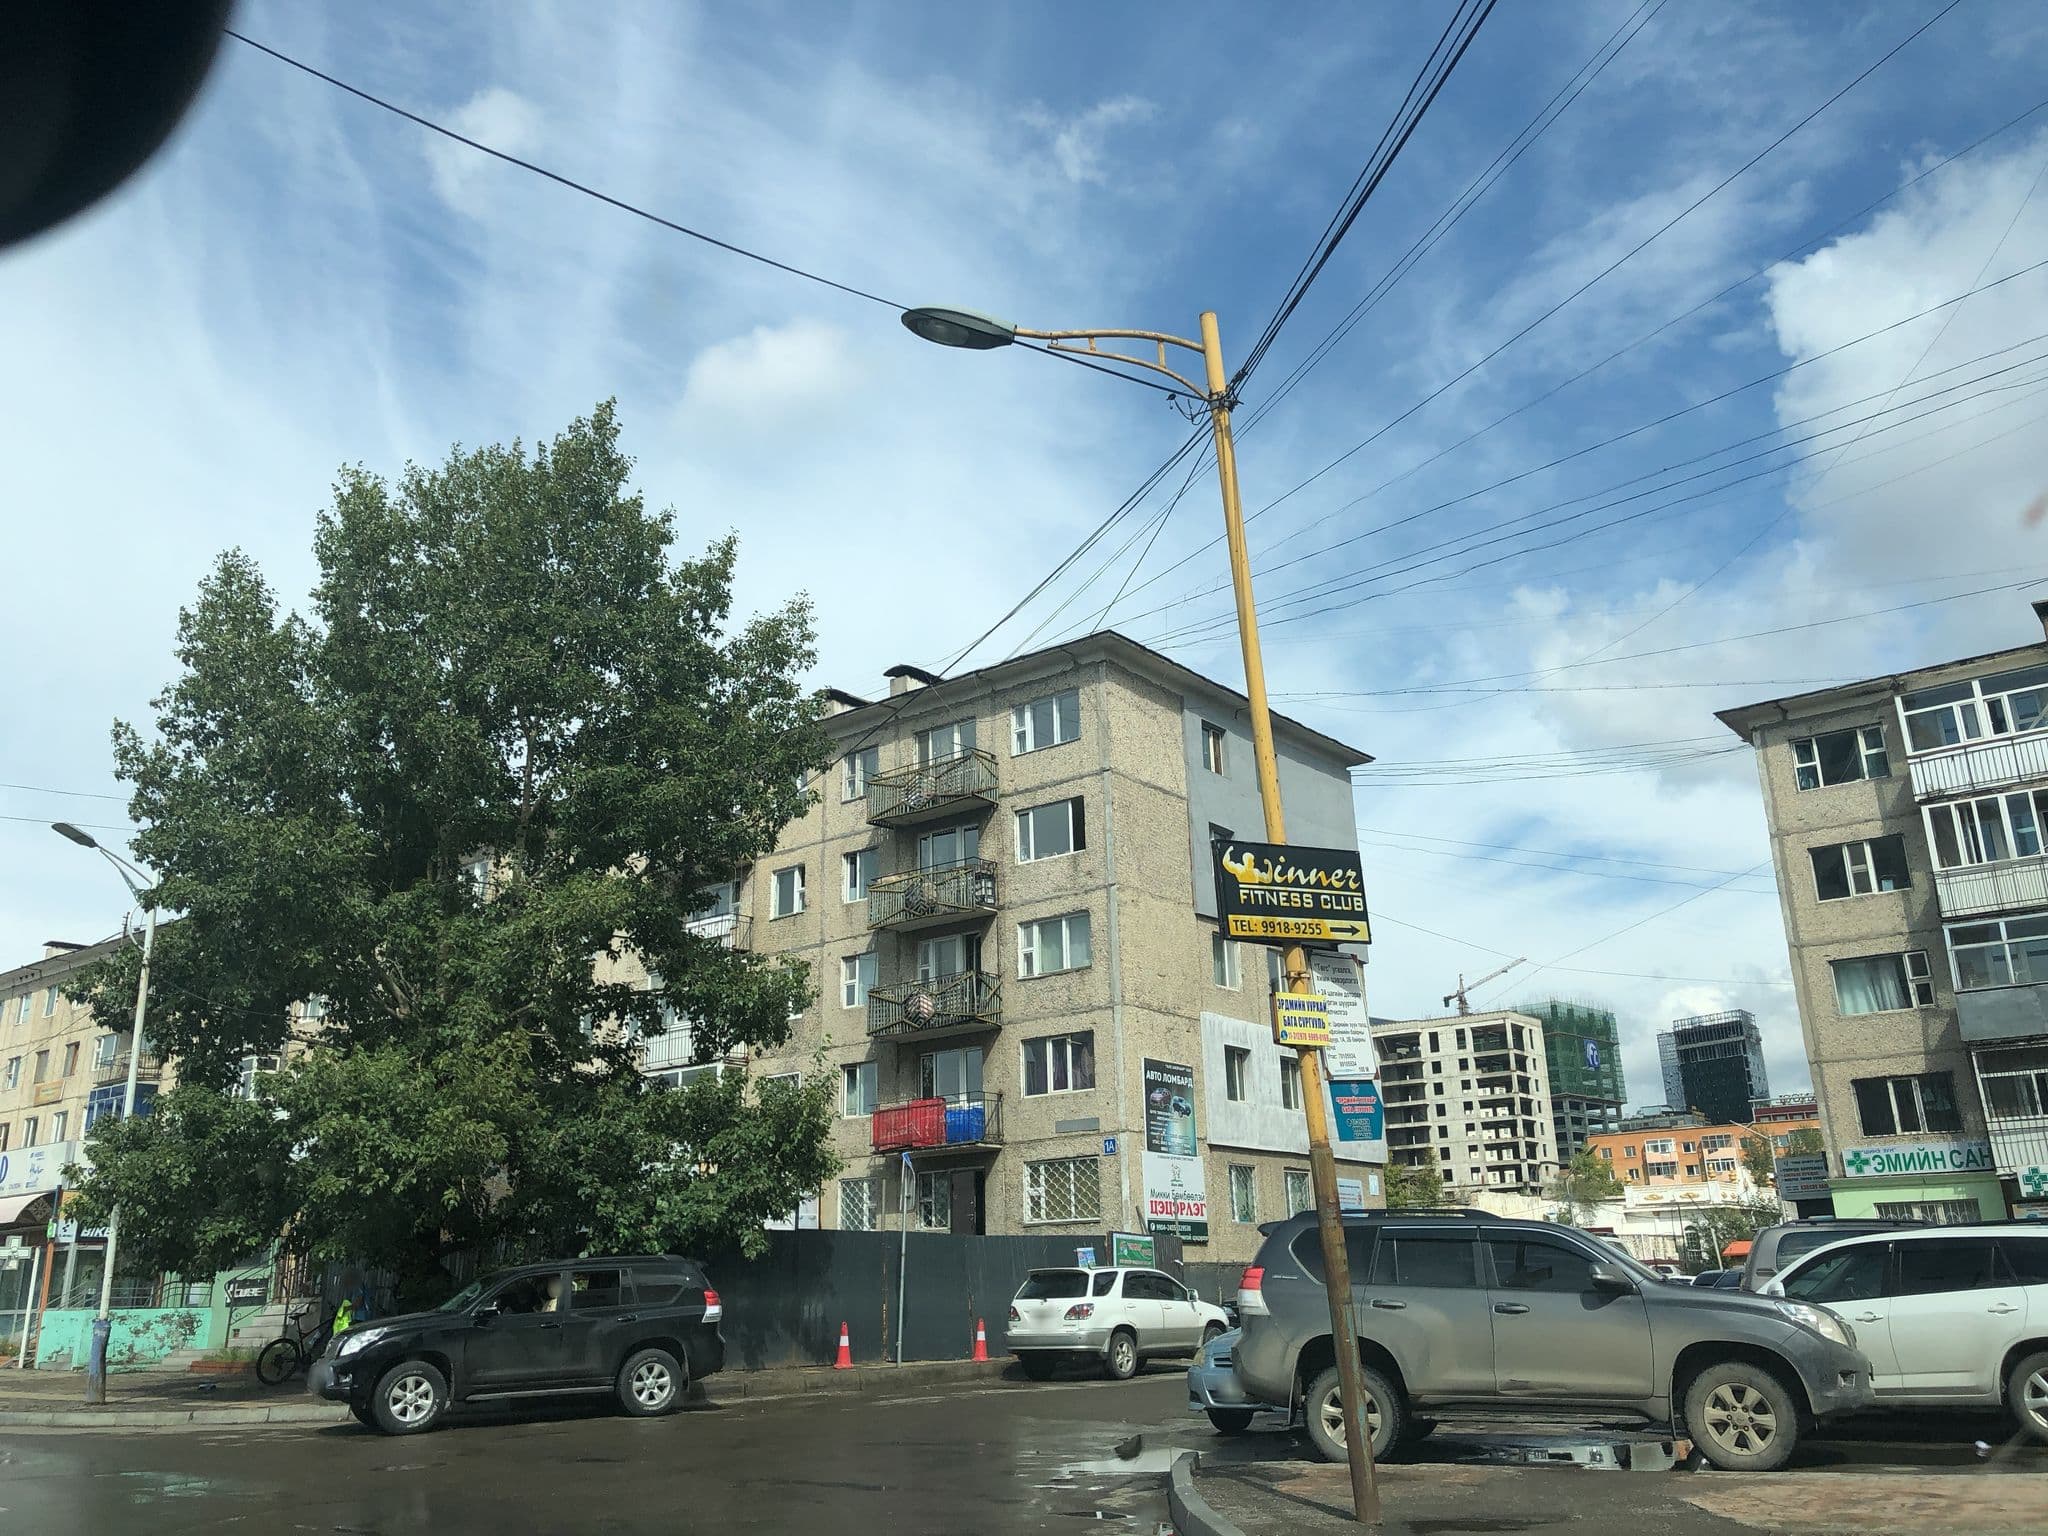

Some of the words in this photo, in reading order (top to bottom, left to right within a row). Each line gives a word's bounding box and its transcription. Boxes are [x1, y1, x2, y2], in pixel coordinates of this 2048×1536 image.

[1239, 889, 1314, 908] FITNESS
[1320, 894, 1364, 912] CLUB
[1232, 919, 1258, 933] TEL:
[1261, 920, 1322, 936] 9918-9255
[1283, 1015, 1298, 1028] БАГА
[1145, 1069, 1162, 1082] АВТО
[1162, 1072, 1194, 1089] ЛОМБАРД
[1872, 1147, 1947, 1172] ЭМИЙН
